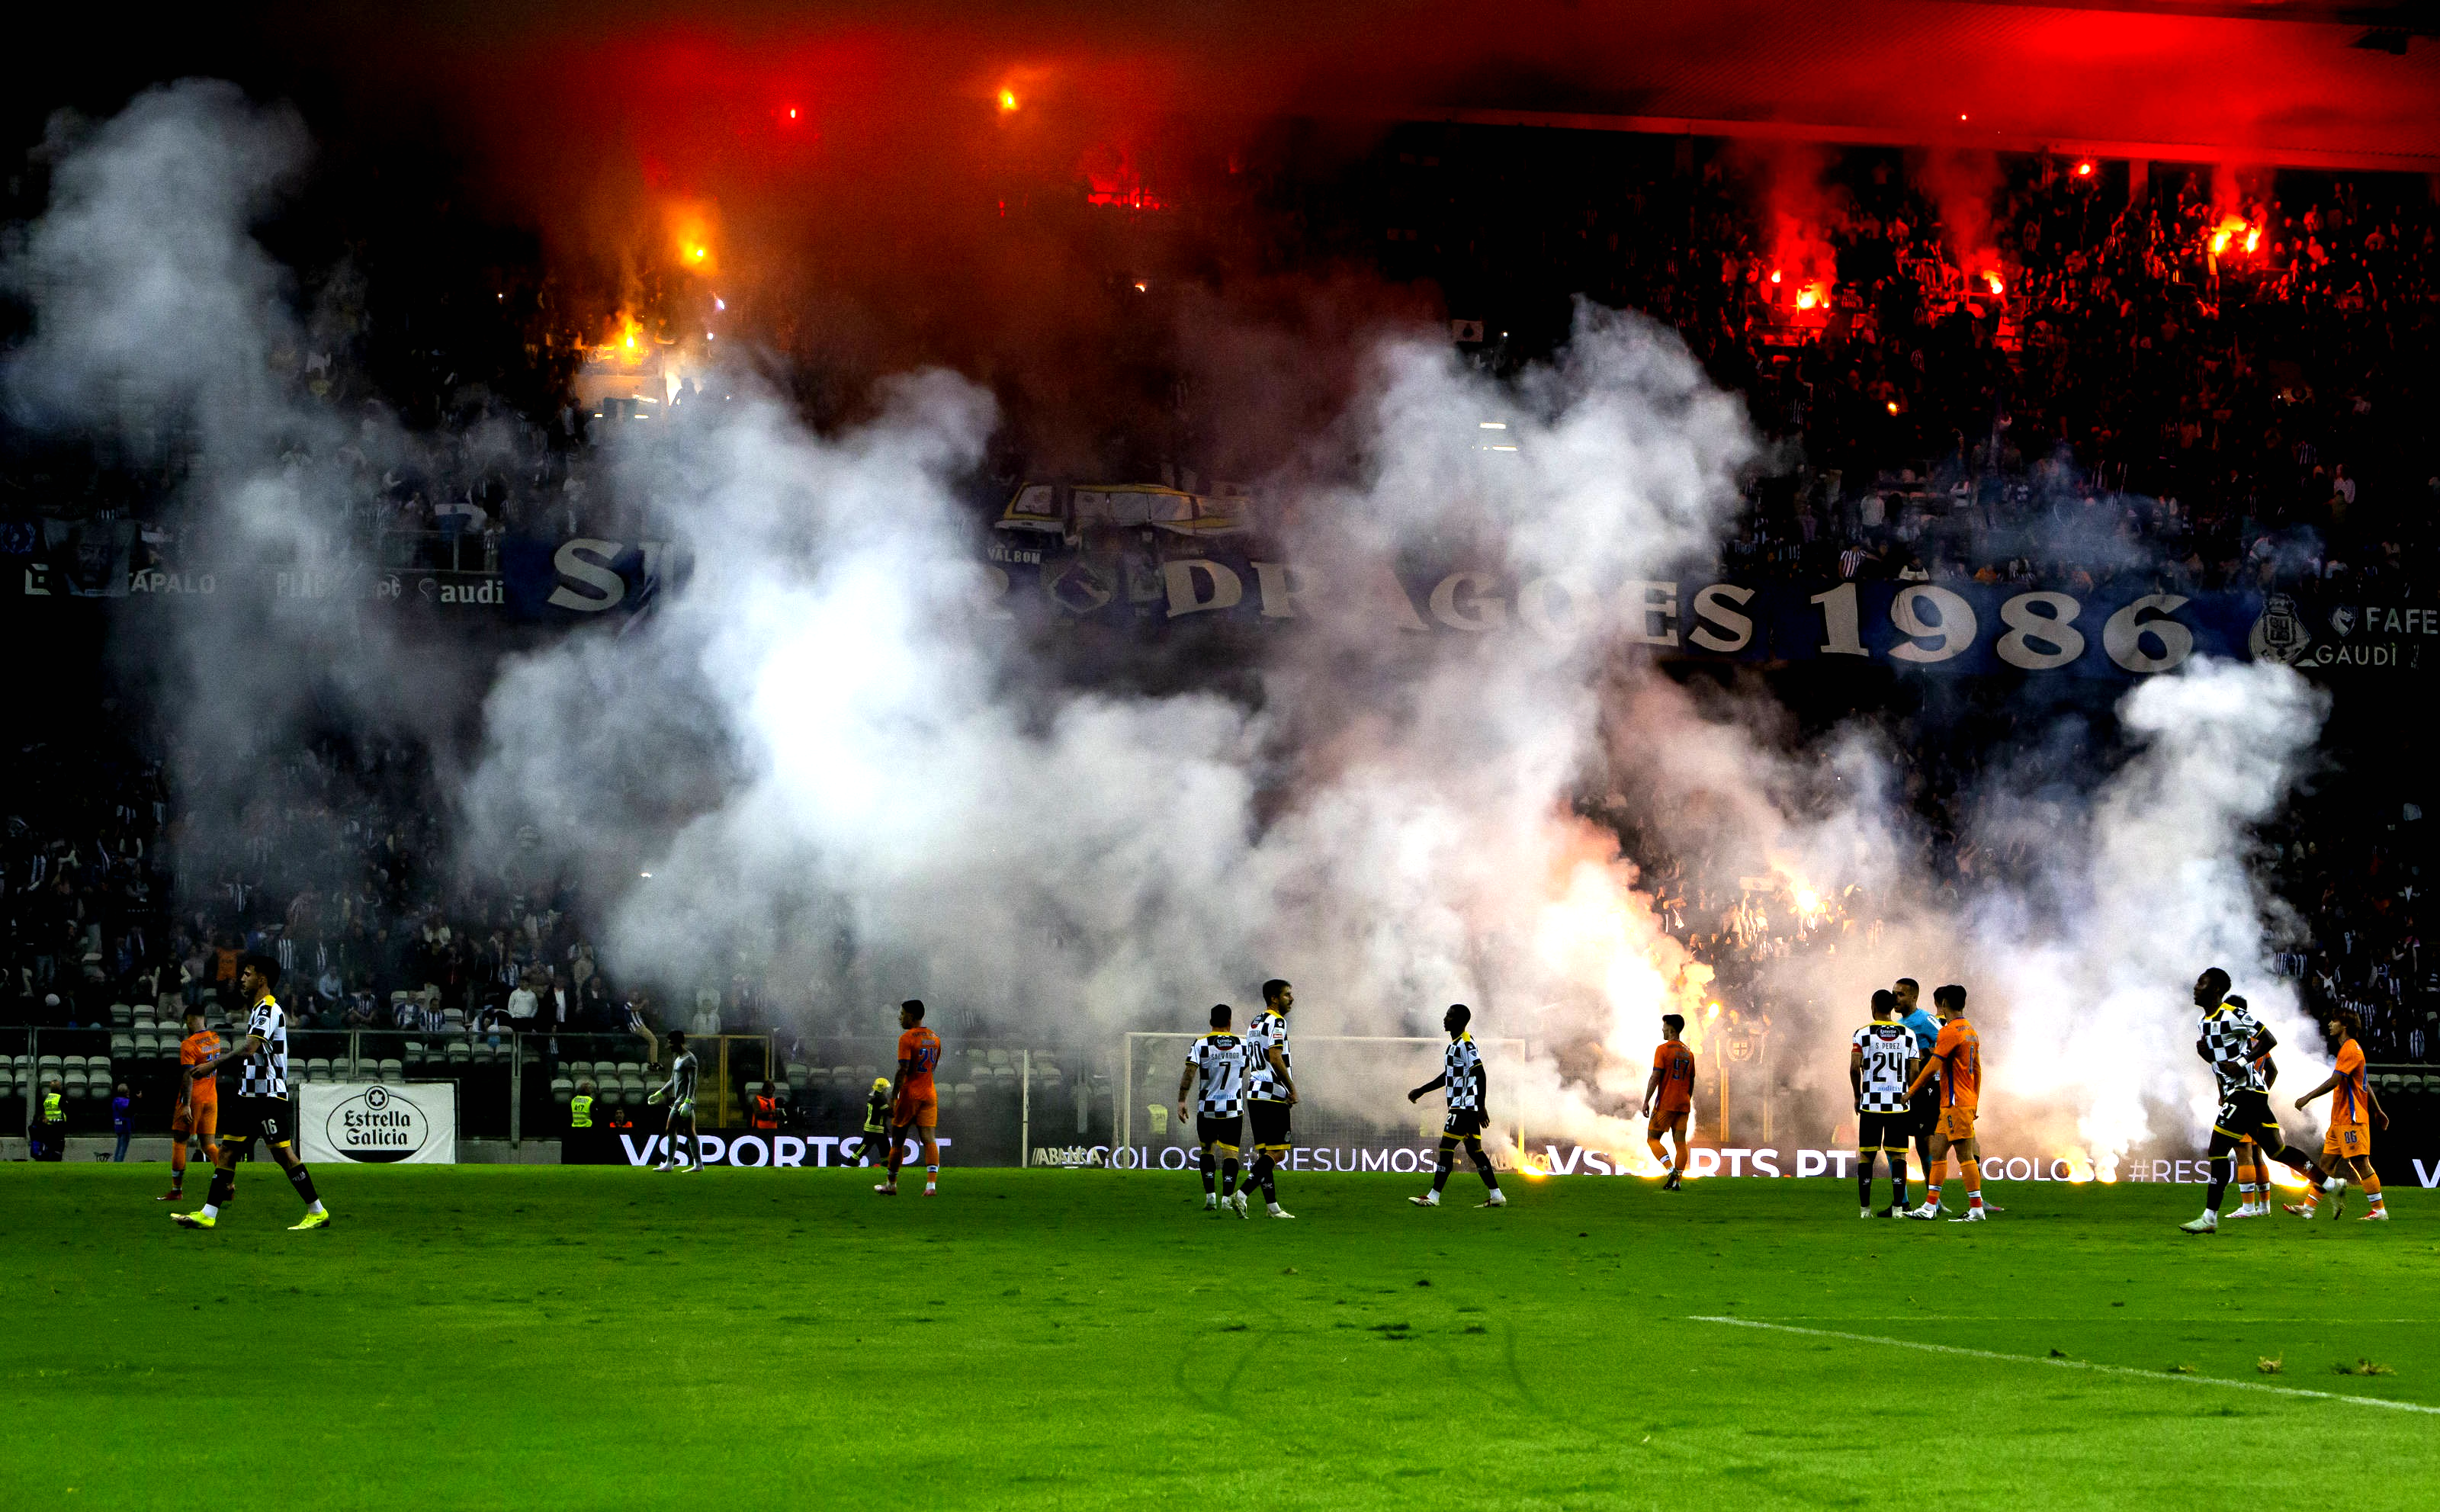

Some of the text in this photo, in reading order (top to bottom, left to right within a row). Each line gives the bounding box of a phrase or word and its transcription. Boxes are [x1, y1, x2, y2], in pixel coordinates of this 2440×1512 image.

[1810, 582, 2194, 673] 1986
[2366, 607, 2439, 634] FAFE
[1211, 1052, 1240, 1061] SALVADOR
[1218, 1061, 1231, 1090] 7
[1872, 1051, 1902, 1083] 24
[343, 1109, 410, 1127] Estrella
[1446, 1112, 1457, 1126] 21
[2218, 1102, 2238, 1119] 27
[261, 1118, 278, 1135] 16
[346, 1128, 408, 1145] Galicia
[1546, 1145, 1857, 1178] VSRTS.PT
